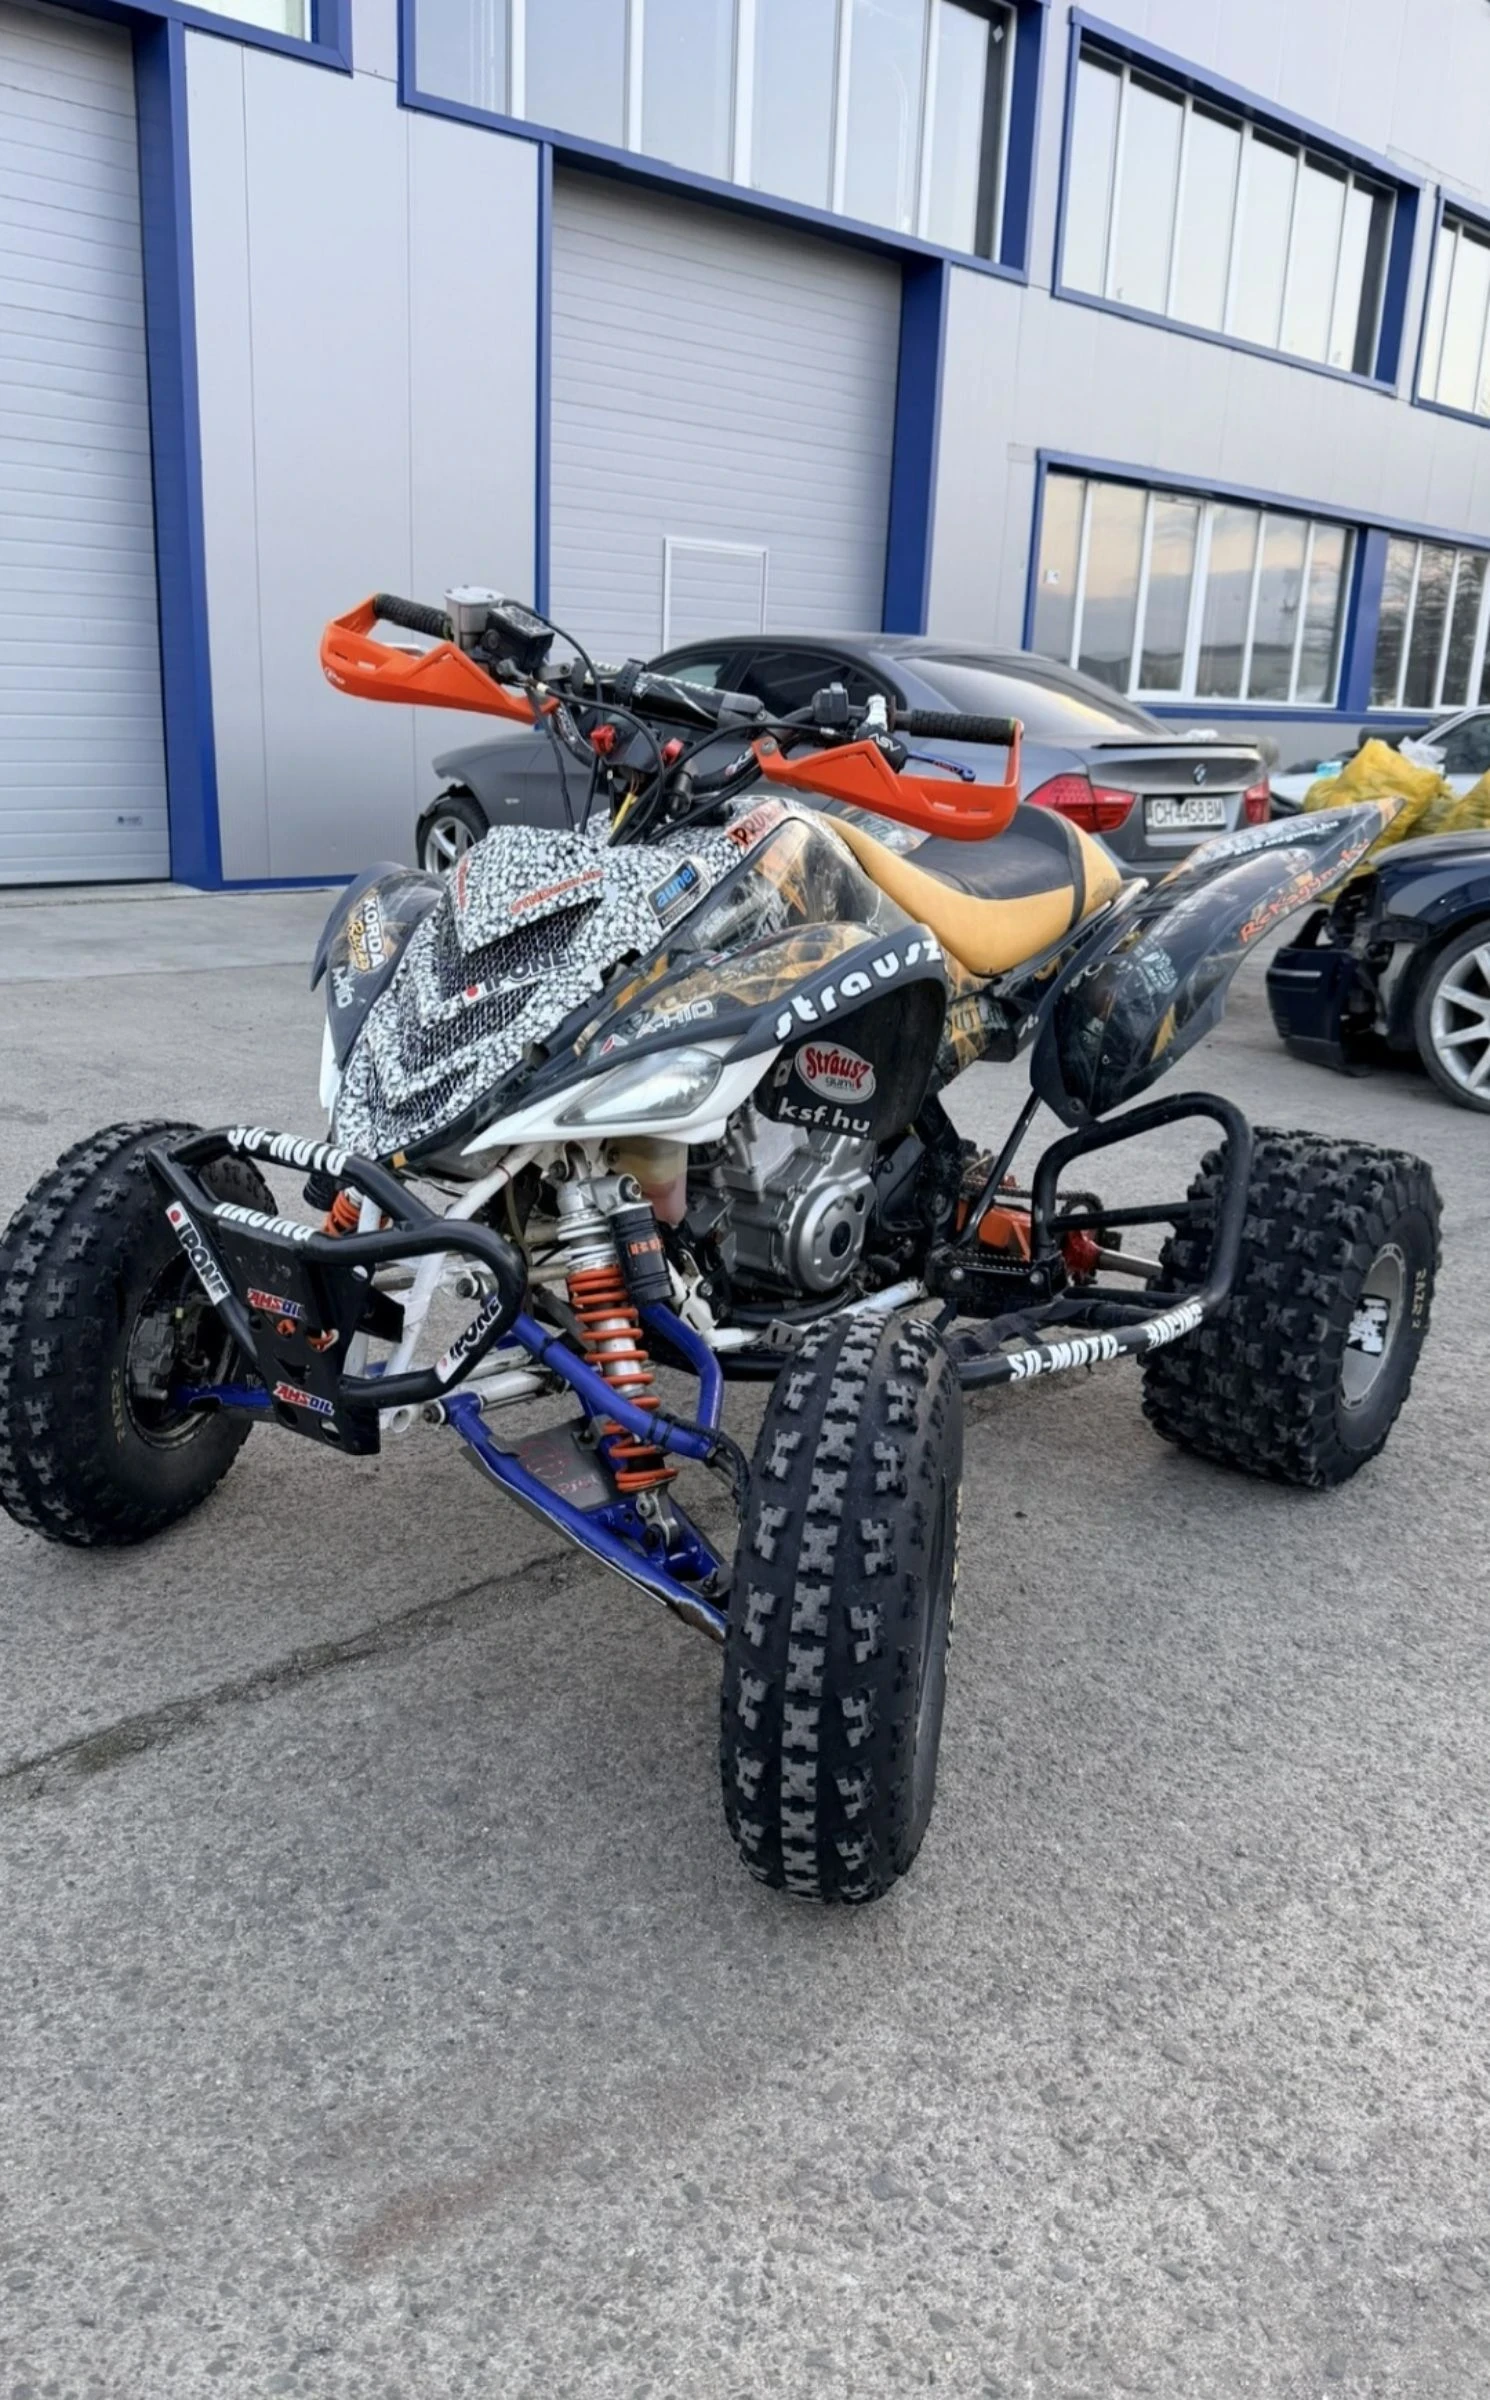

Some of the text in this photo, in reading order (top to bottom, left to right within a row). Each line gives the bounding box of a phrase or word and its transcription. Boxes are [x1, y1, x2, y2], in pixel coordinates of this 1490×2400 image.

[362, 897, 387, 969] KORDA
[483, 950, 569, 993] IPONE
[774, 939, 942, 1041] strausz
[778, 1097, 870, 1133] ksf.hu
[176, 1222, 230, 1304] IPONE
[447, 1296, 503, 1363] IPONE
[274, 1382, 335, 1415] AMSOIL
